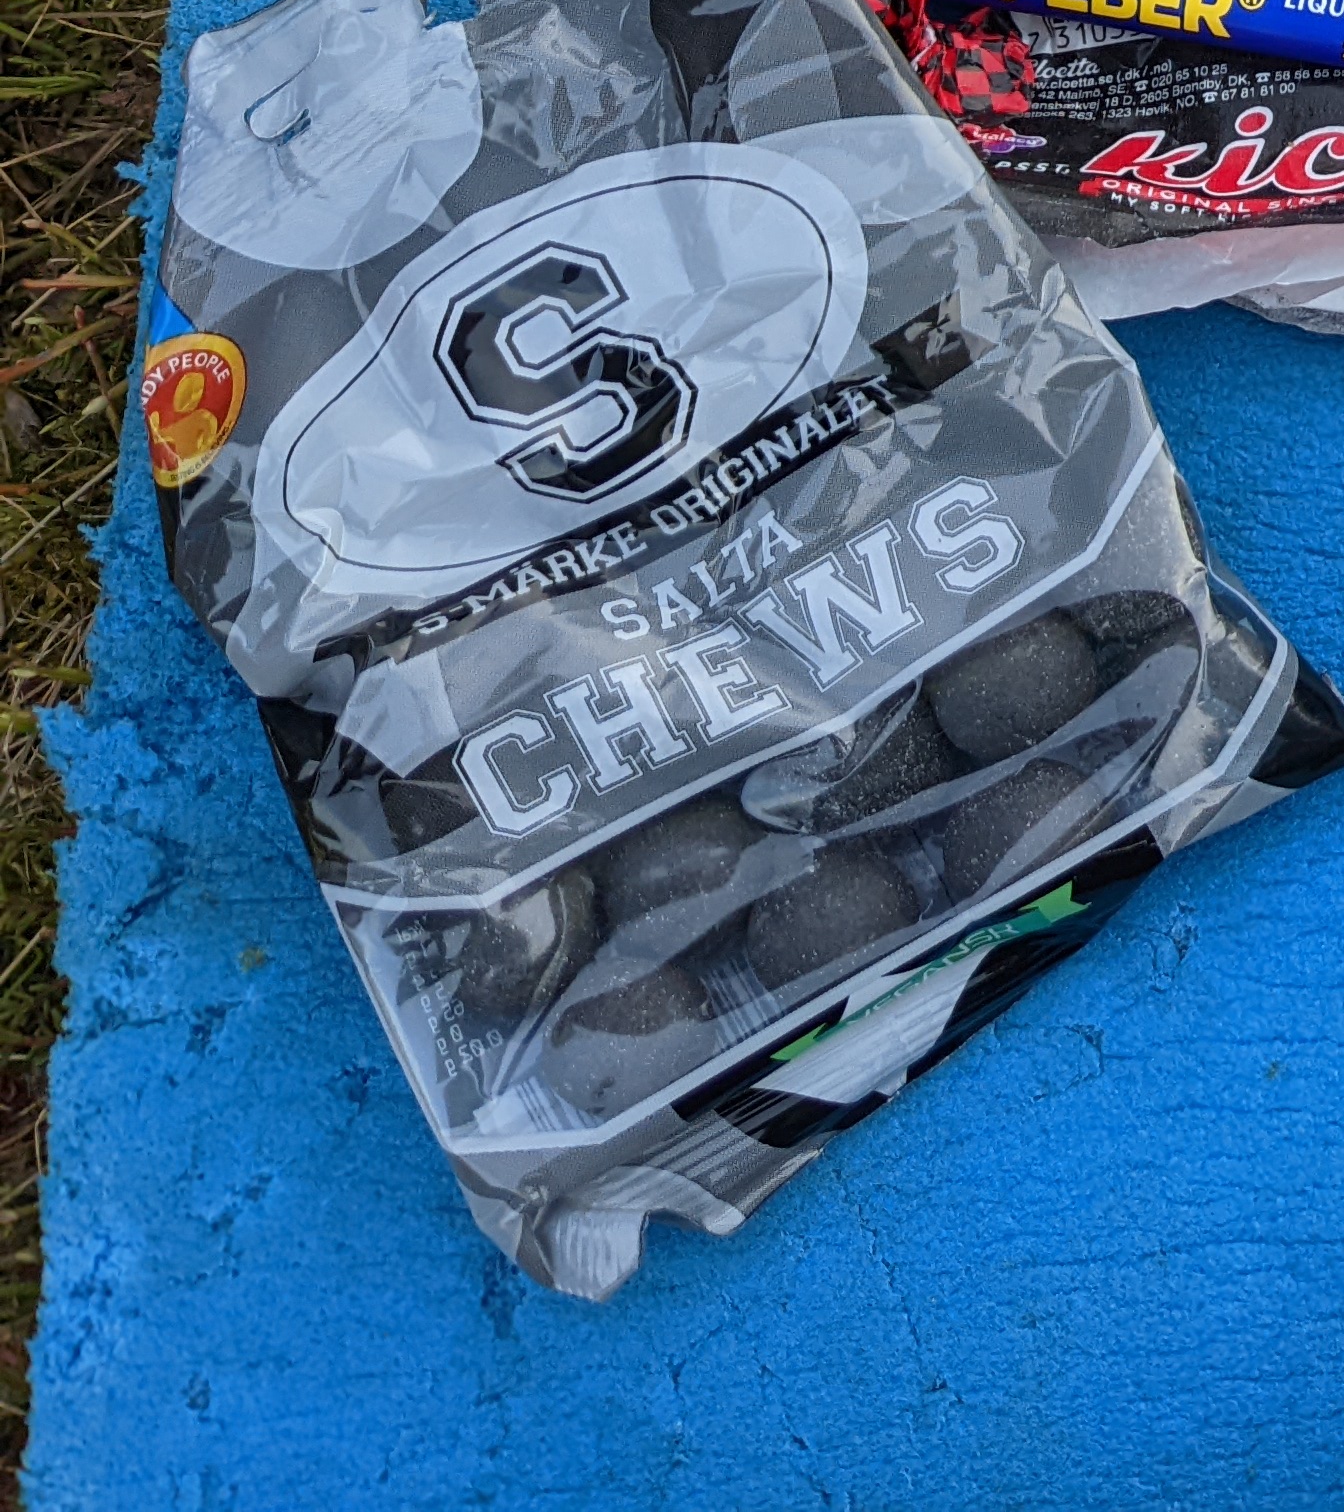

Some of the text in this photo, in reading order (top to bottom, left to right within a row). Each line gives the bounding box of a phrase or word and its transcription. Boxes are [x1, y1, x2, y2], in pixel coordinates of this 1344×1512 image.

[1037, 91, 1057, 100] 42
[1151, 74, 1173, 88] 020
[1175, 66, 1190, 81] 65
[1193, 64, 1208, 78] 10
[1211, 63, 1228, 76] 25
[1104, 96, 1119, 108] 18
[1140, 89, 1170, 105] 2605
[1228, 74, 1251, 87] DK,
[1102, 107, 1133, 119] 1323
[1221, 88, 1236, 101] 67
[1240, 86, 1255, 100] 81
[1260, 84, 1275, 97] 81
[1279, 82, 1297, 95] 00
[1102, 179, 1251, 213] ORIGINAL
[1111, 191, 1137, 207] MY
[1149, 200, 1207, 217] SOFT
[168, 352, 231, 384] PEOPLE
[434, 241, 698, 503] S
[413, 374, 898, 636] S-MÄRKE ORIGINALET
[600, 510, 804, 641] SALTA
[454, 476, 1025, 838] CHEWS
